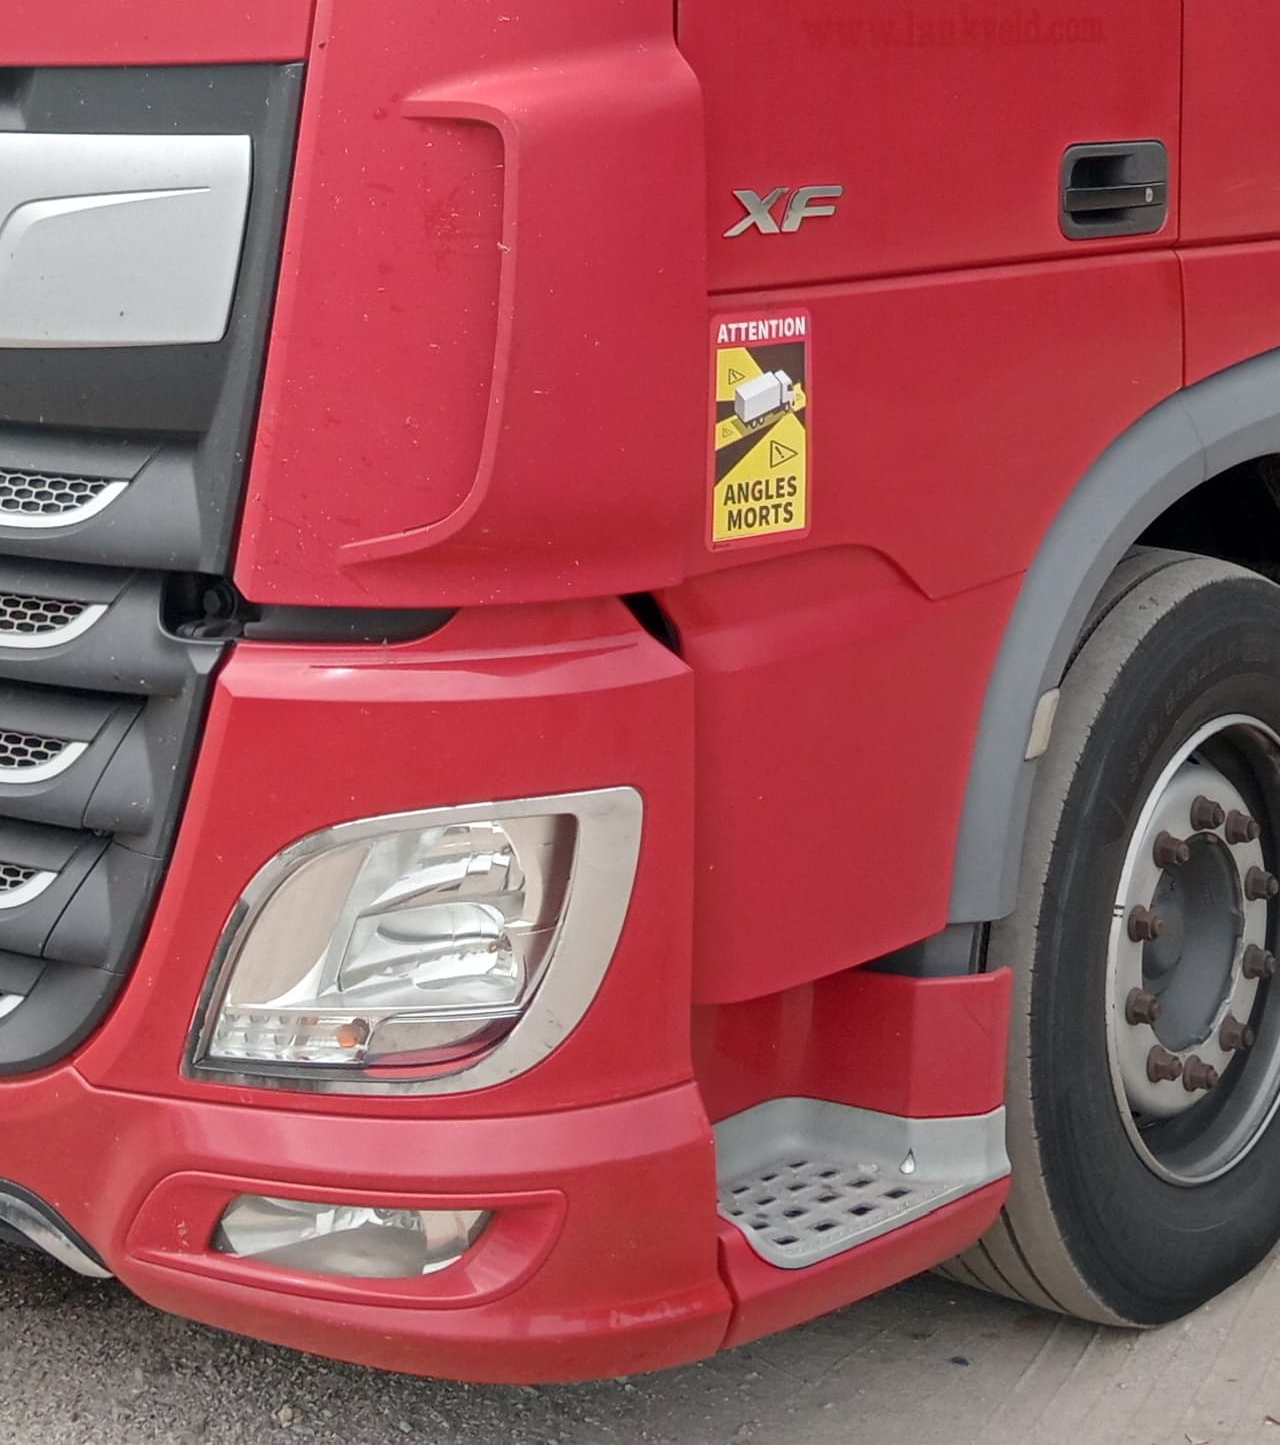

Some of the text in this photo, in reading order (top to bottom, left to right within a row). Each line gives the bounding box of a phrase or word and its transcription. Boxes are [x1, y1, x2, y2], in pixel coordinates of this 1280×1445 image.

[723, 185, 842, 237] XF
[717, 316, 806, 343] ATTENTION
[723, 475, 797, 507] ANGLES
[727, 502, 794, 532] MORTS
